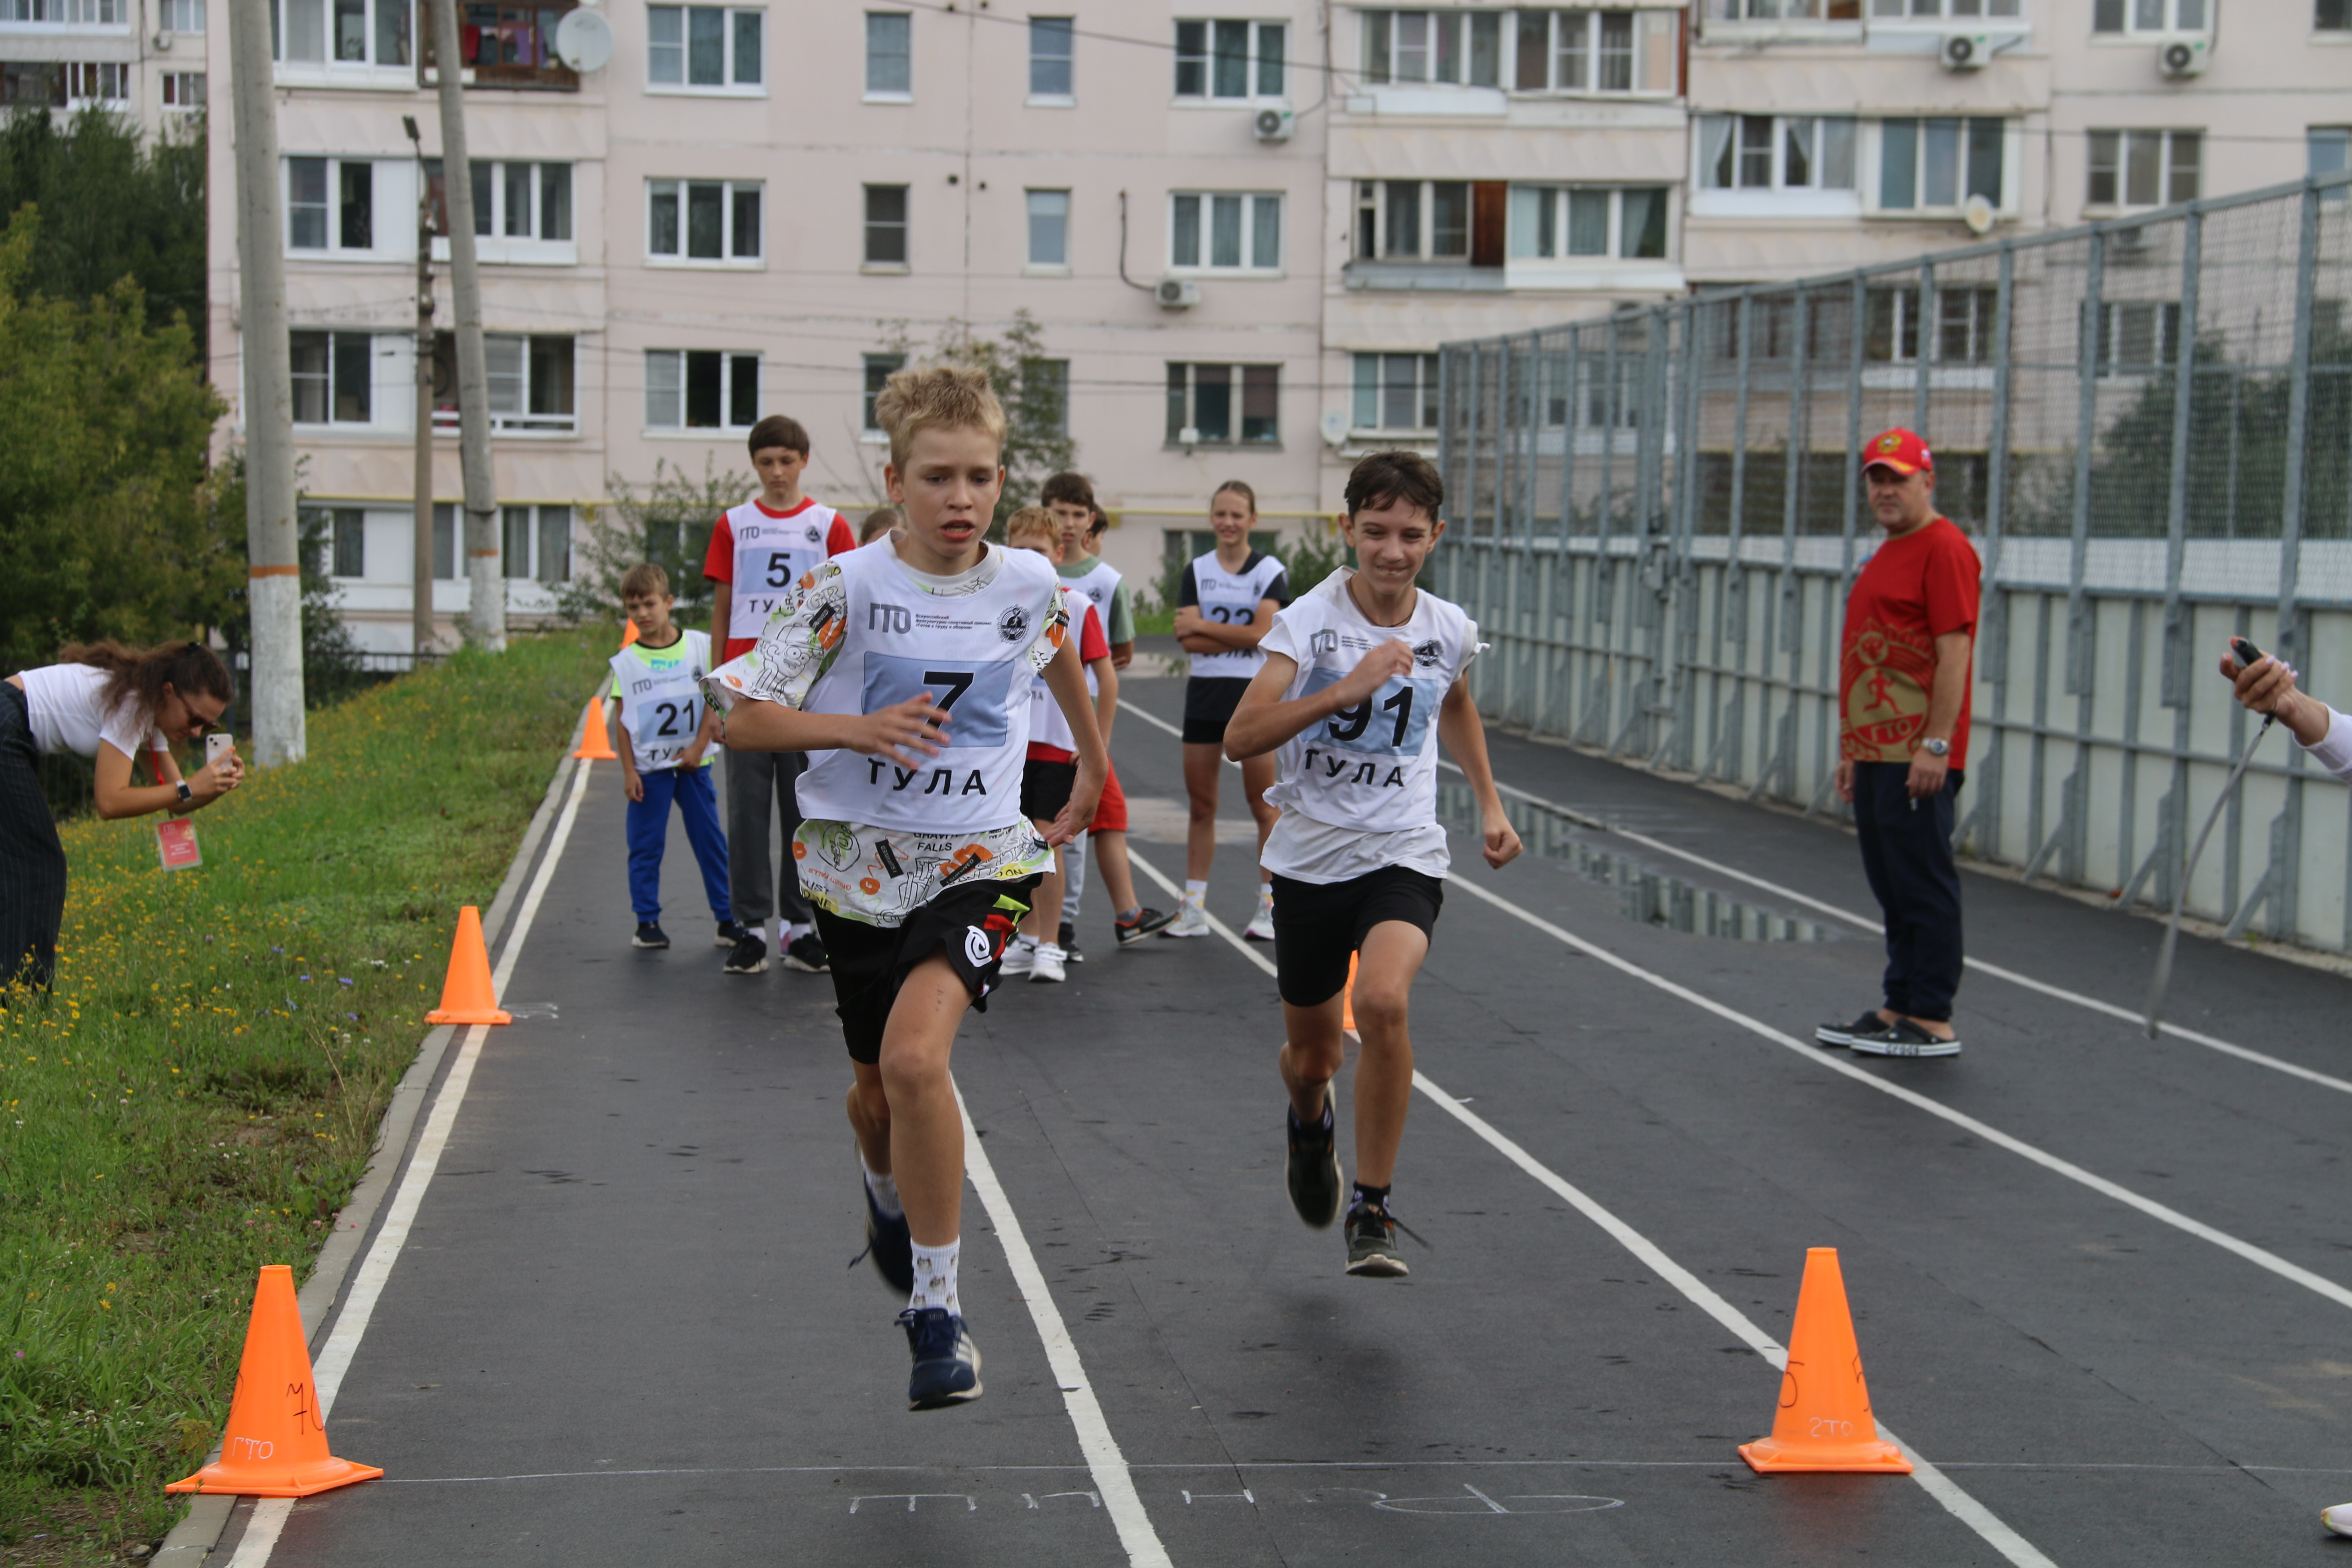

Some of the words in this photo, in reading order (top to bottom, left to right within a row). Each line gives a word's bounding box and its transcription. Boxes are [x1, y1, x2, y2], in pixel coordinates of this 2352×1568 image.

[740, 526, 759, 540] ГТО
[766, 552, 791, 588] 5
[1201, 579, 1216, 591] ГТО
[749, 599, 773, 613] ТУ
[869, 603, 911, 634] ГТО
[633, 678, 652, 695] ГТО
[655, 699, 695, 736] 21
[920, 671, 974, 740] 7
[1328, 686, 1413, 747] 91
[1871, 720, 1911, 743] ГТО
[868, 758, 986, 796] ТУЛА
[1305, 749, 1404, 787] ТУЛА
[881, 845, 896, 870] SURVIVED
[917, 842, 952, 852] FALLS
[808, 868, 829, 880] FALLS
[949, 859, 974, 881] SURVIVED
[232, 1436, 273, 1460] ГТО
